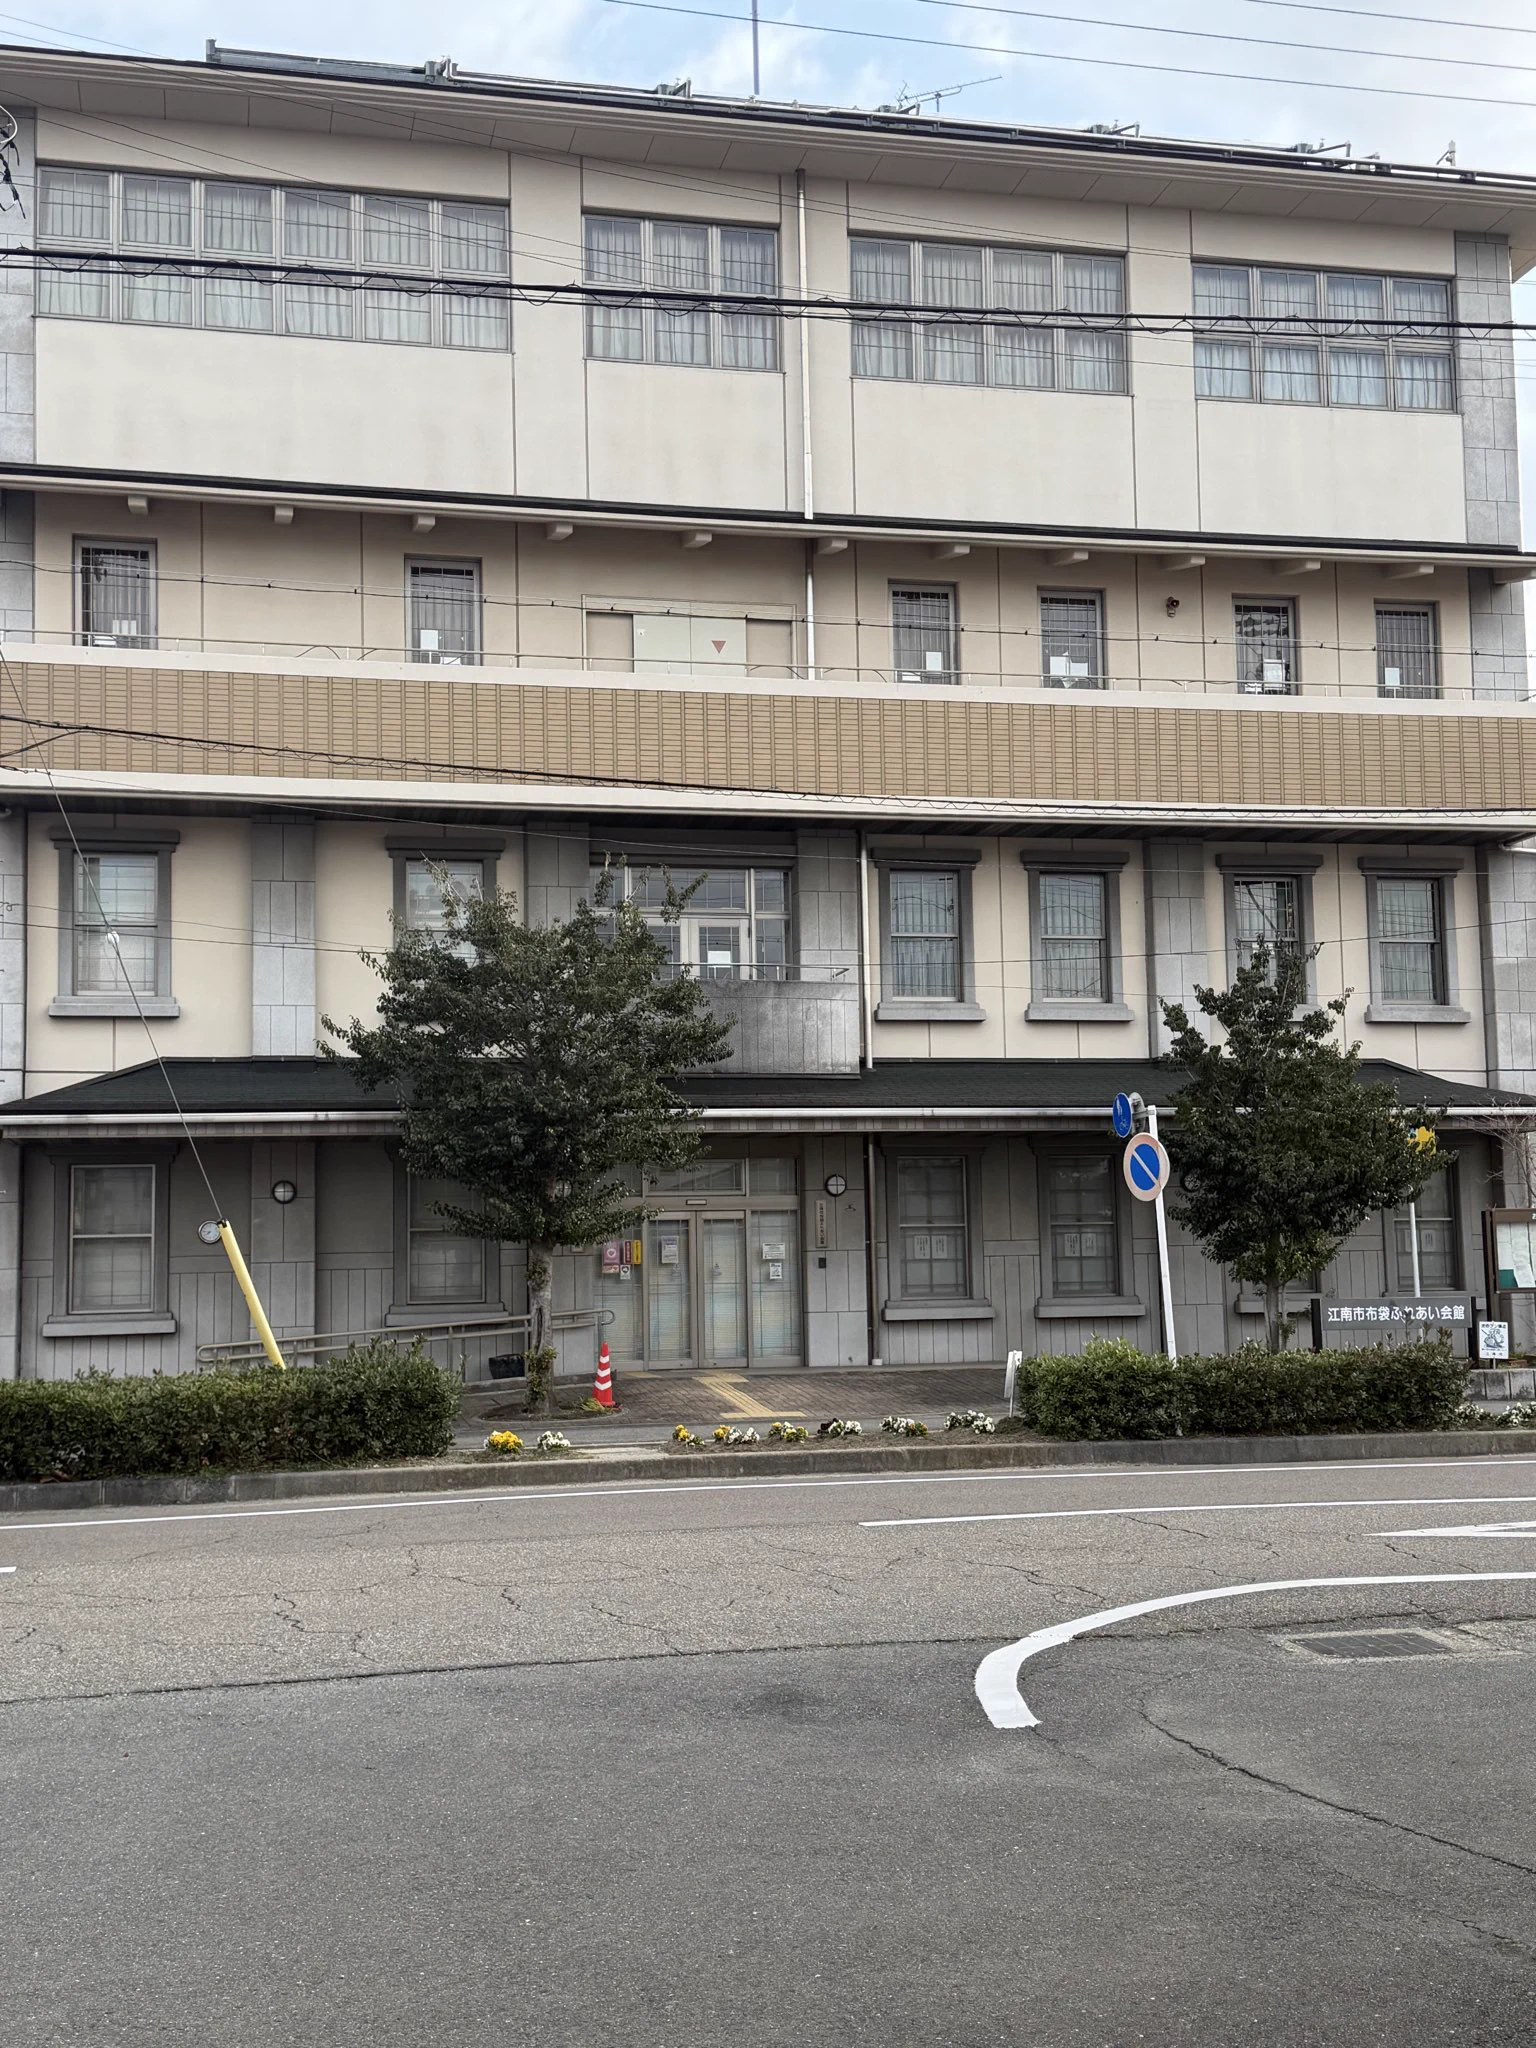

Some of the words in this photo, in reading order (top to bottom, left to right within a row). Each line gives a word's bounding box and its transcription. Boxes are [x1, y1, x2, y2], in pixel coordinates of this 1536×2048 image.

[1328, 1305, 1465, 1322] 江南市布袋ふれあい会館
